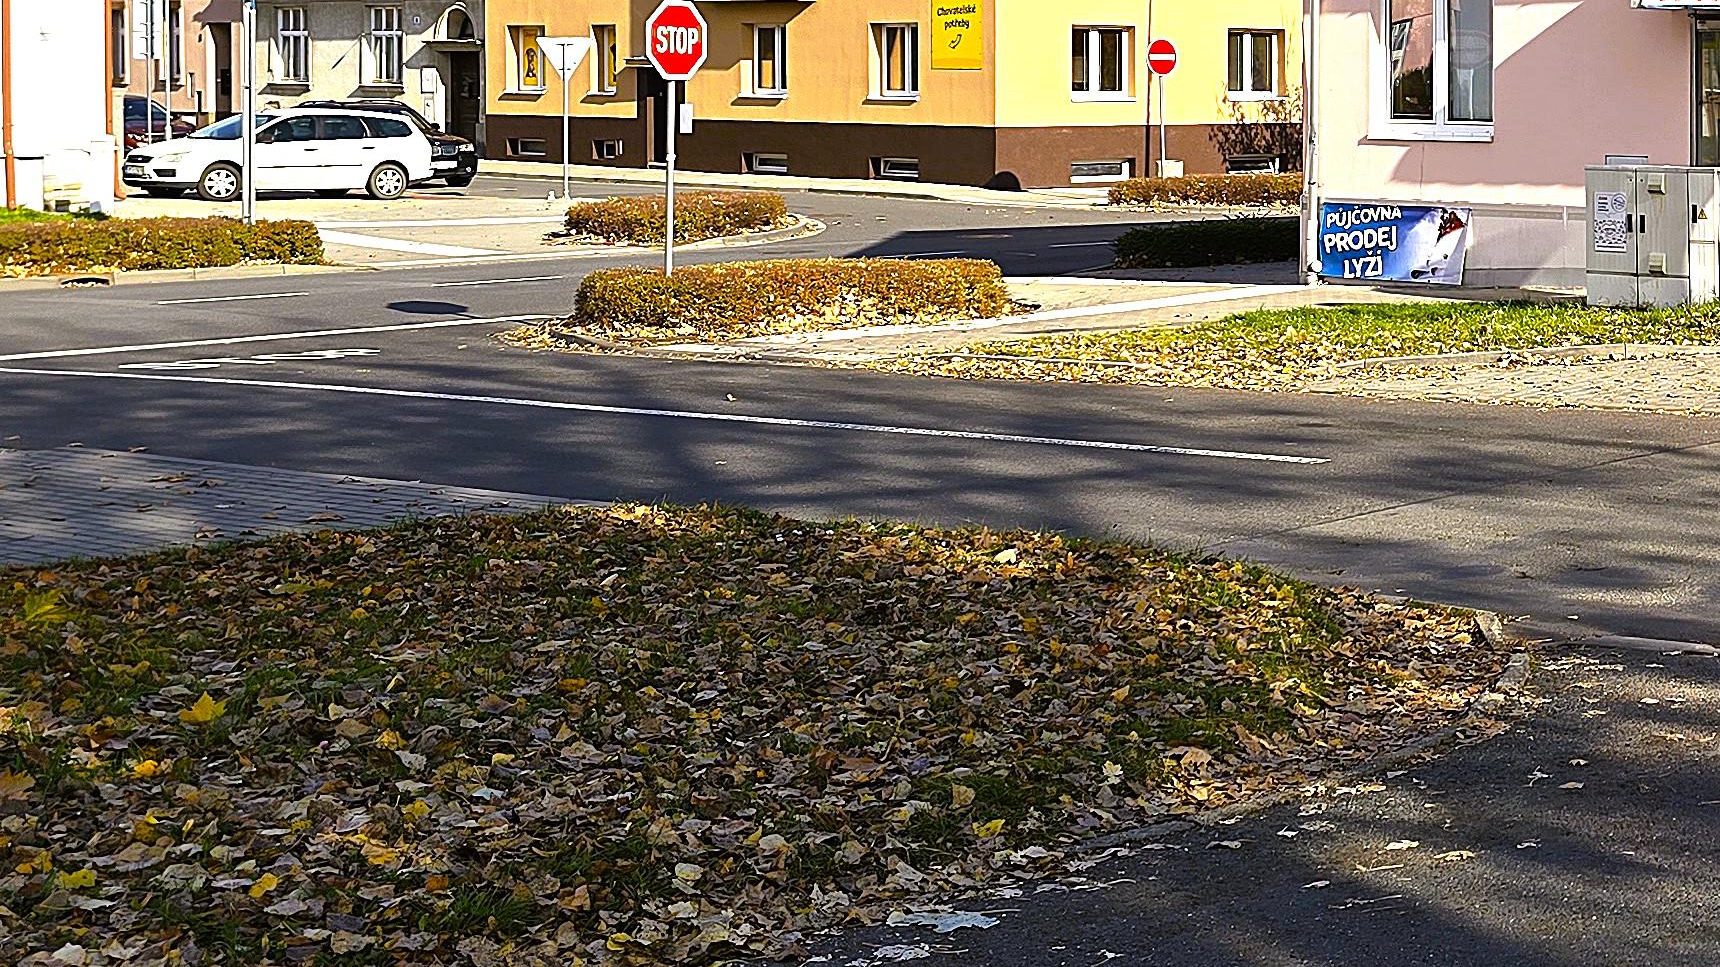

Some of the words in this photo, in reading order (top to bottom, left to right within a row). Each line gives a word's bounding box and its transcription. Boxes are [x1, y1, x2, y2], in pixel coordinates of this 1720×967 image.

[655, 25, 699, 55] STOP
[1326, 205, 1402, 230] PŮJČOVNA
[1323, 225, 1397, 254] PRODEJ
[1343, 249, 1383, 279] LYŽÍ
